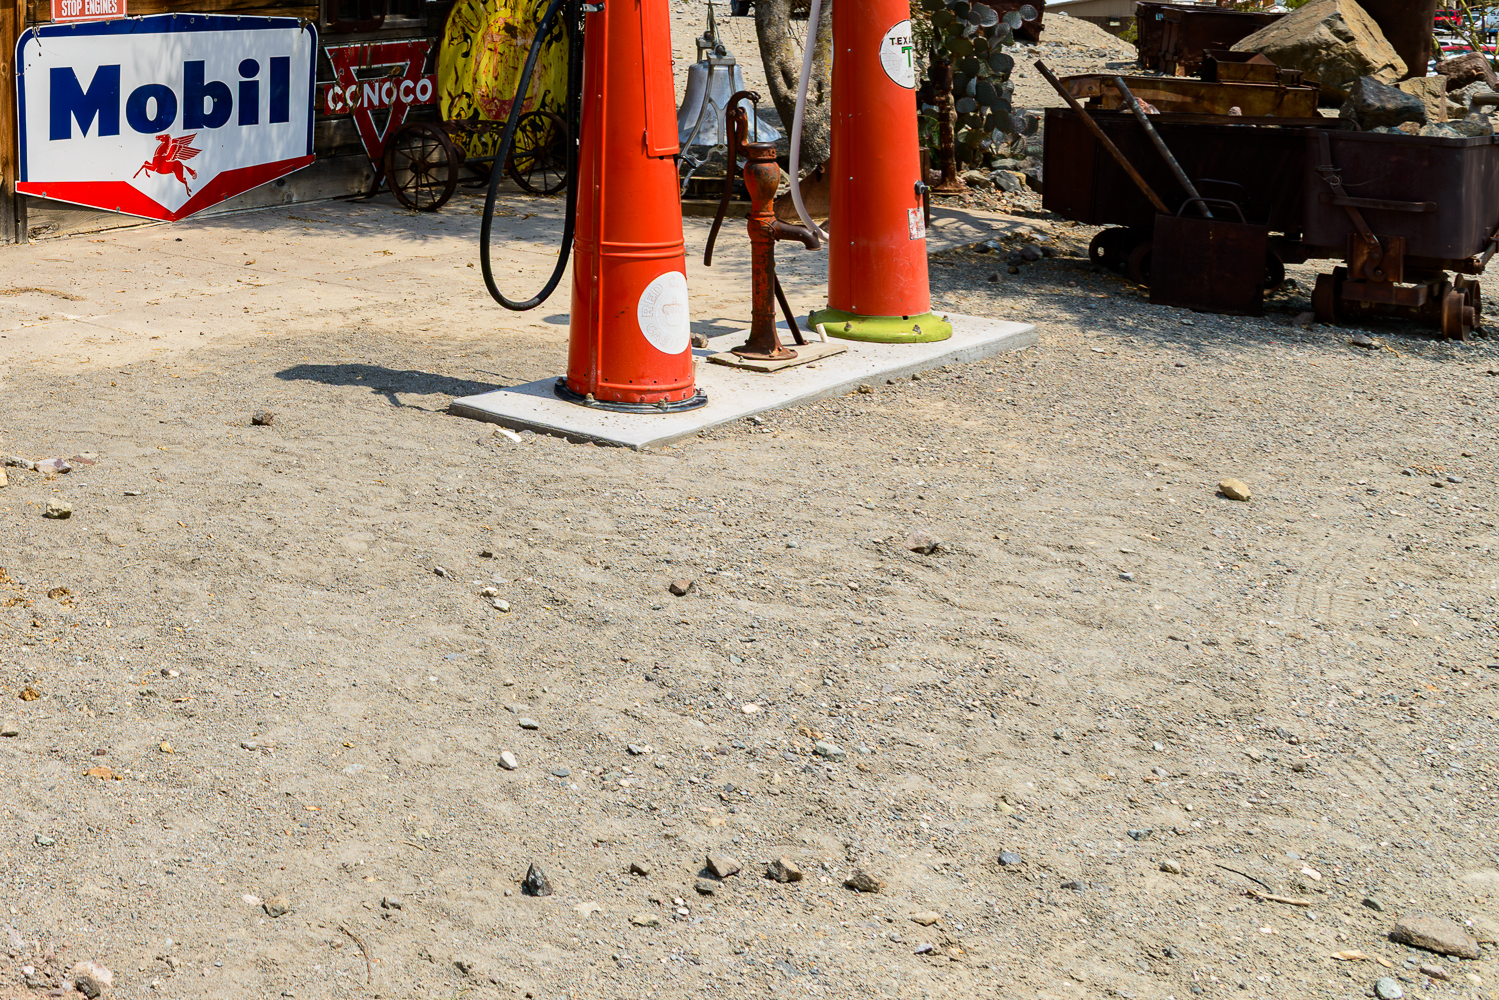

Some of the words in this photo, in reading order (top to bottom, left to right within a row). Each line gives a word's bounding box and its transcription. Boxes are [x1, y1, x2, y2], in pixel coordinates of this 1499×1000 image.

[61, 0, 82, 16] STOP
[889, 36, 912, 46] TEX
[49, 56, 290, 141] Mobil
[327, 78, 433, 111] CONOCO
